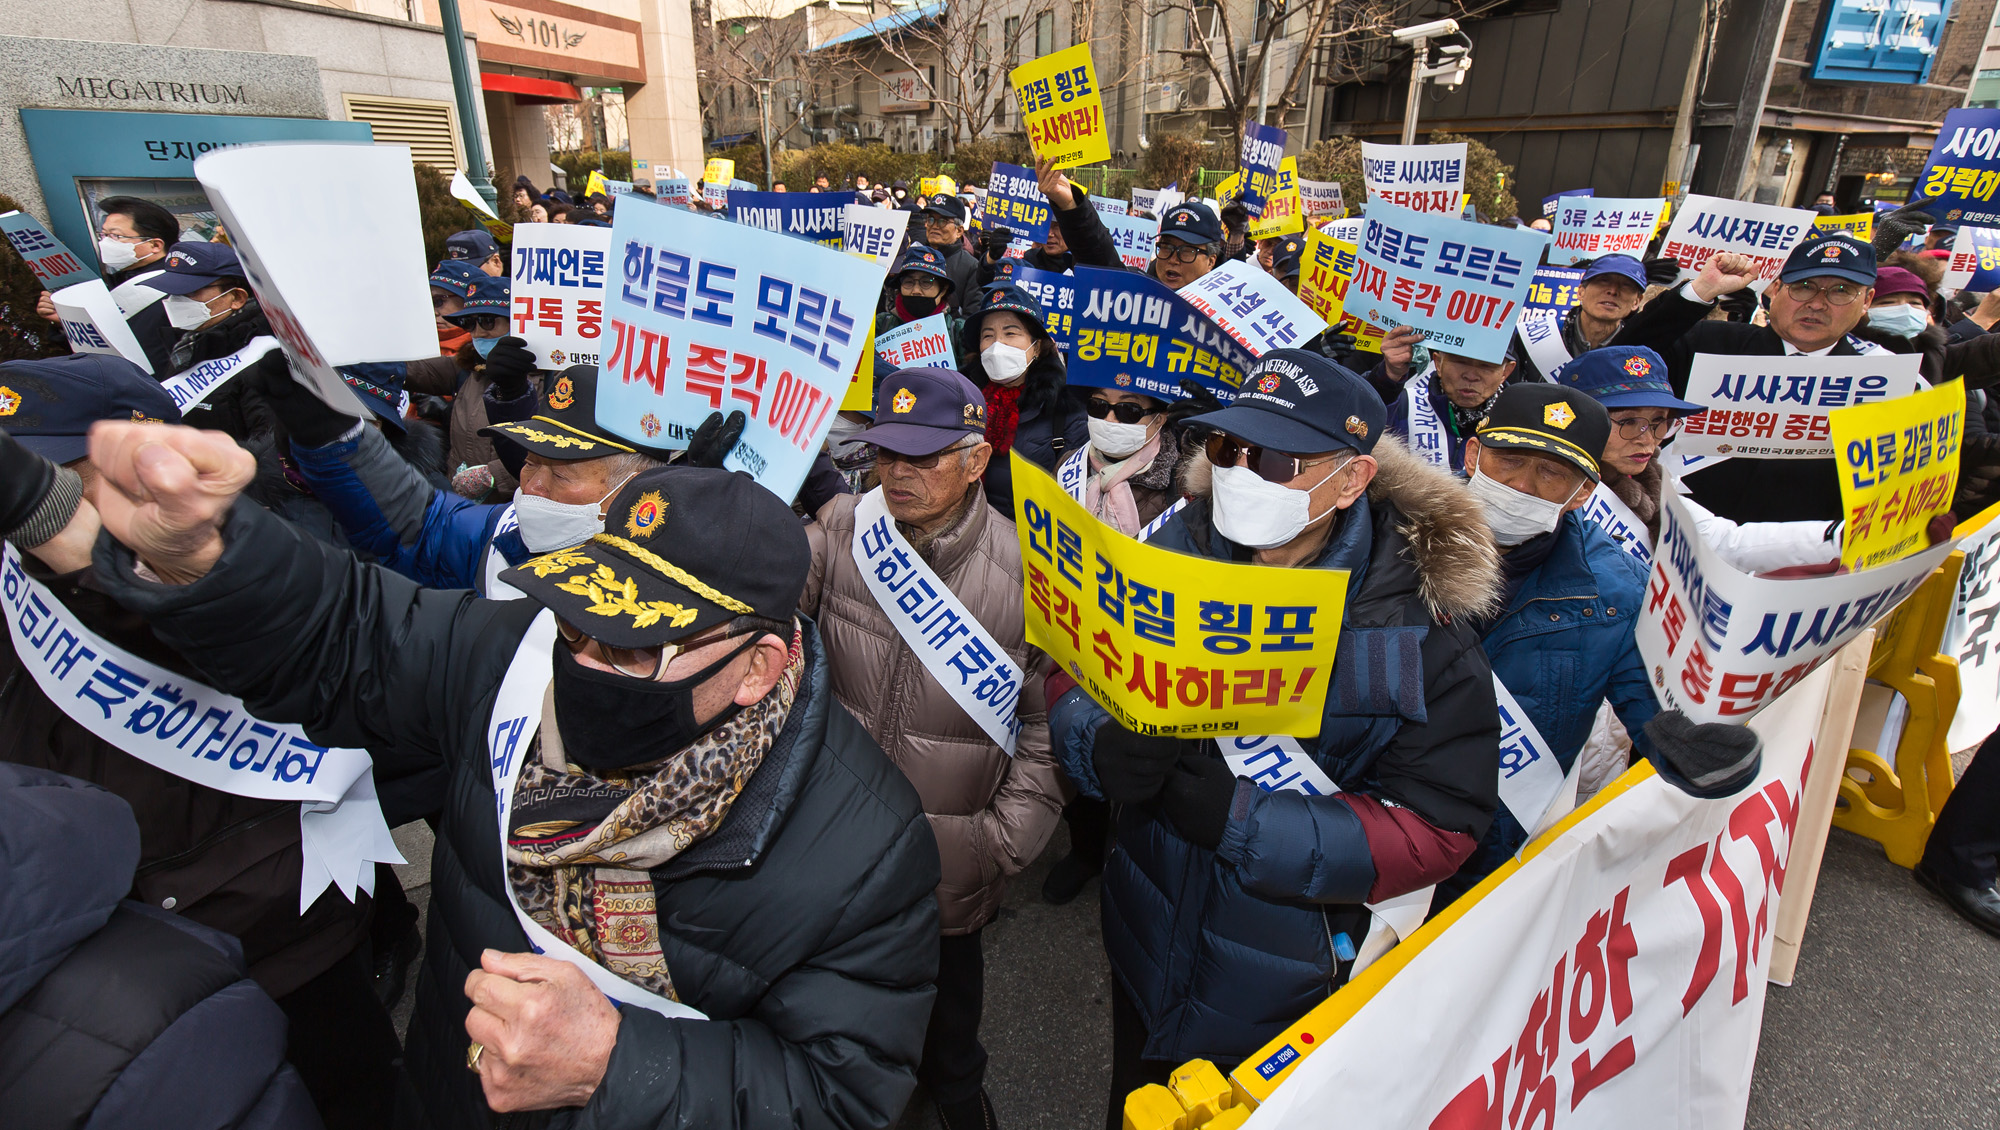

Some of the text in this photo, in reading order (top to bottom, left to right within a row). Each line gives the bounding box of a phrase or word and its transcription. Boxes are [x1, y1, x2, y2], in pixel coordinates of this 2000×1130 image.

[528, 18, 559, 48] 101
[57, 77, 249, 104] MEGATRIUM
[1024, 77, 1054, 113] 갑질
[1055, 65, 1092, 103] 횡포
[1032, 105, 1098, 150] 수사하라!
[1399, 158, 1460, 184] 시사저널
[999, 198, 1010, 219] 못
[1011, 202, 1048, 226] 먹냐?
[1563, 208, 1654, 229] 3류 소설 쓰는
[843, 222, 895, 257] 저널은
[1112, 227, 1134, 249] 소설
[1554, 231, 1648, 252] 시사저널 각성하라!
[1687, 212, 1799, 250] 시사저널은
[39, 252, 81, 276] OUT!
[516, 247, 604, 288] 가짜언론
[1314, 240, 1356, 277] 본분
[1365, 219, 1522, 289] 한글도 모르는
[1664, 240, 1732, 273] 불법행
[1308, 265, 1350, 302] 시사
[1353, 257, 1515, 331] 기자 즉각 OUT!
[513, 297, 602, 338] 구독 중
[622, 241, 855, 373] 한글도 모르는
[1047, 312, 1058, 335] 못
[1082, 288, 1172, 329] 사이비
[1198, 270, 1235, 291] 3류
[1218, 281, 1266, 319] 소설
[1251, 308, 1299, 350] 쓰는
[901, 333, 947, 362] 시사저널
[1381, 315, 1465, 348] 대한재향군인회
[185, 354, 241, 396] KOREAN
[1077, 328, 1244, 389] 강력히 규탄한
[607, 318, 833, 453] 기자 즉각 OUT!
[1264, 359, 1303, 380] VETERANS
[1295, 374, 1319, 397] ASSN
[1711, 374, 1889, 407] 시사저널은
[1252, 393, 1295, 410] DEPARTMENT
[1683, 410, 1779, 437] 불법행위
[1847, 431, 1896, 490] 언론
[1900, 420, 1933, 475] 갑질
[1024, 498, 1317, 655] 언론 갑질 횡포
[1028, 560, 1317, 710] 즉각 수사하라!
[1650, 562, 1844, 716] 구독 중단하
[1089, 678, 1239, 736] 대한민국재향군인회
[1277, 1048, 1295, 1064] 0299
